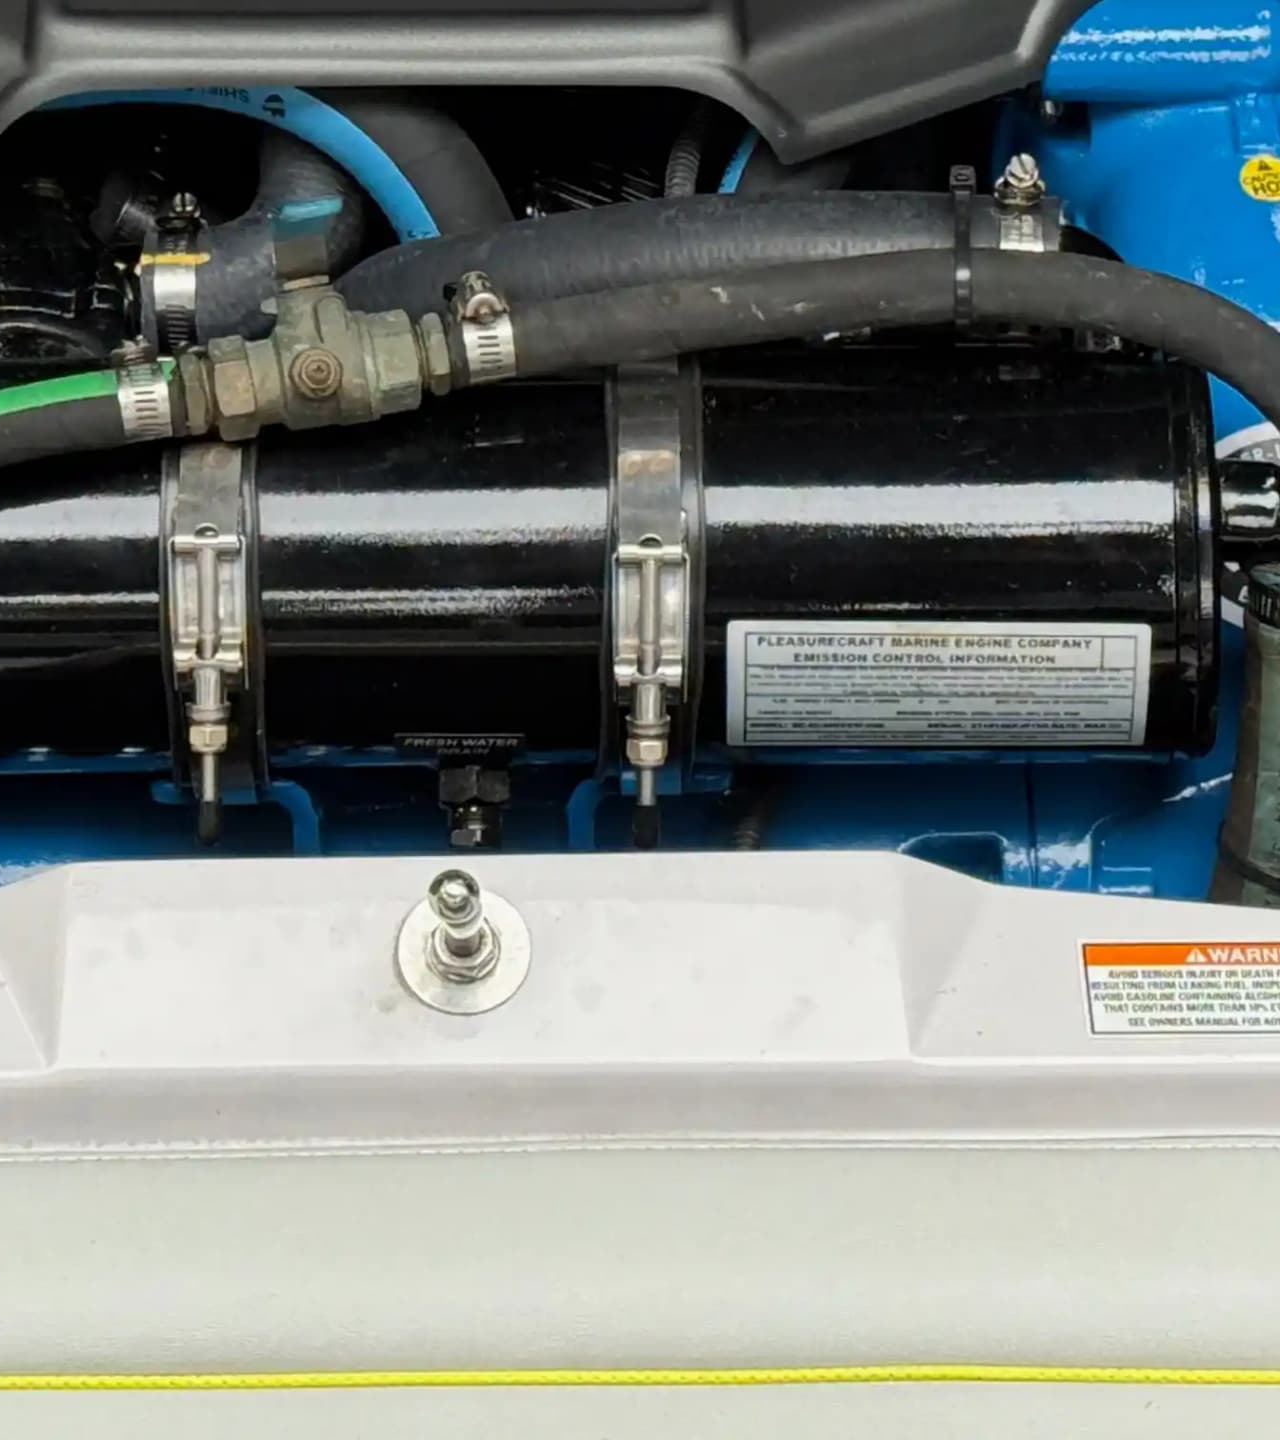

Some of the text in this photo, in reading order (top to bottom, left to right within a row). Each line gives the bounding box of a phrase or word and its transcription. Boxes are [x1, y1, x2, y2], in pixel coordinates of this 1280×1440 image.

[757, 636, 1093, 650] PLEASURECRAFT MARINE ENGINE COMPANY
[793, 652, 1057, 665] EMISSION CONTROL INFORMATION
[403, 738, 519, 747] FRESH WATER
[1127, 992, 1176, 1001] GASOLINE
[1178, 992, 1242, 1001] CONTAINING
[1131, 1004, 1184, 1013] CONTAINS
[1186, 1003, 1216, 1012] MORE
[1219, 1003, 1246, 1012] THAN
[1195, 1017, 1239, 1026] MANUAL
